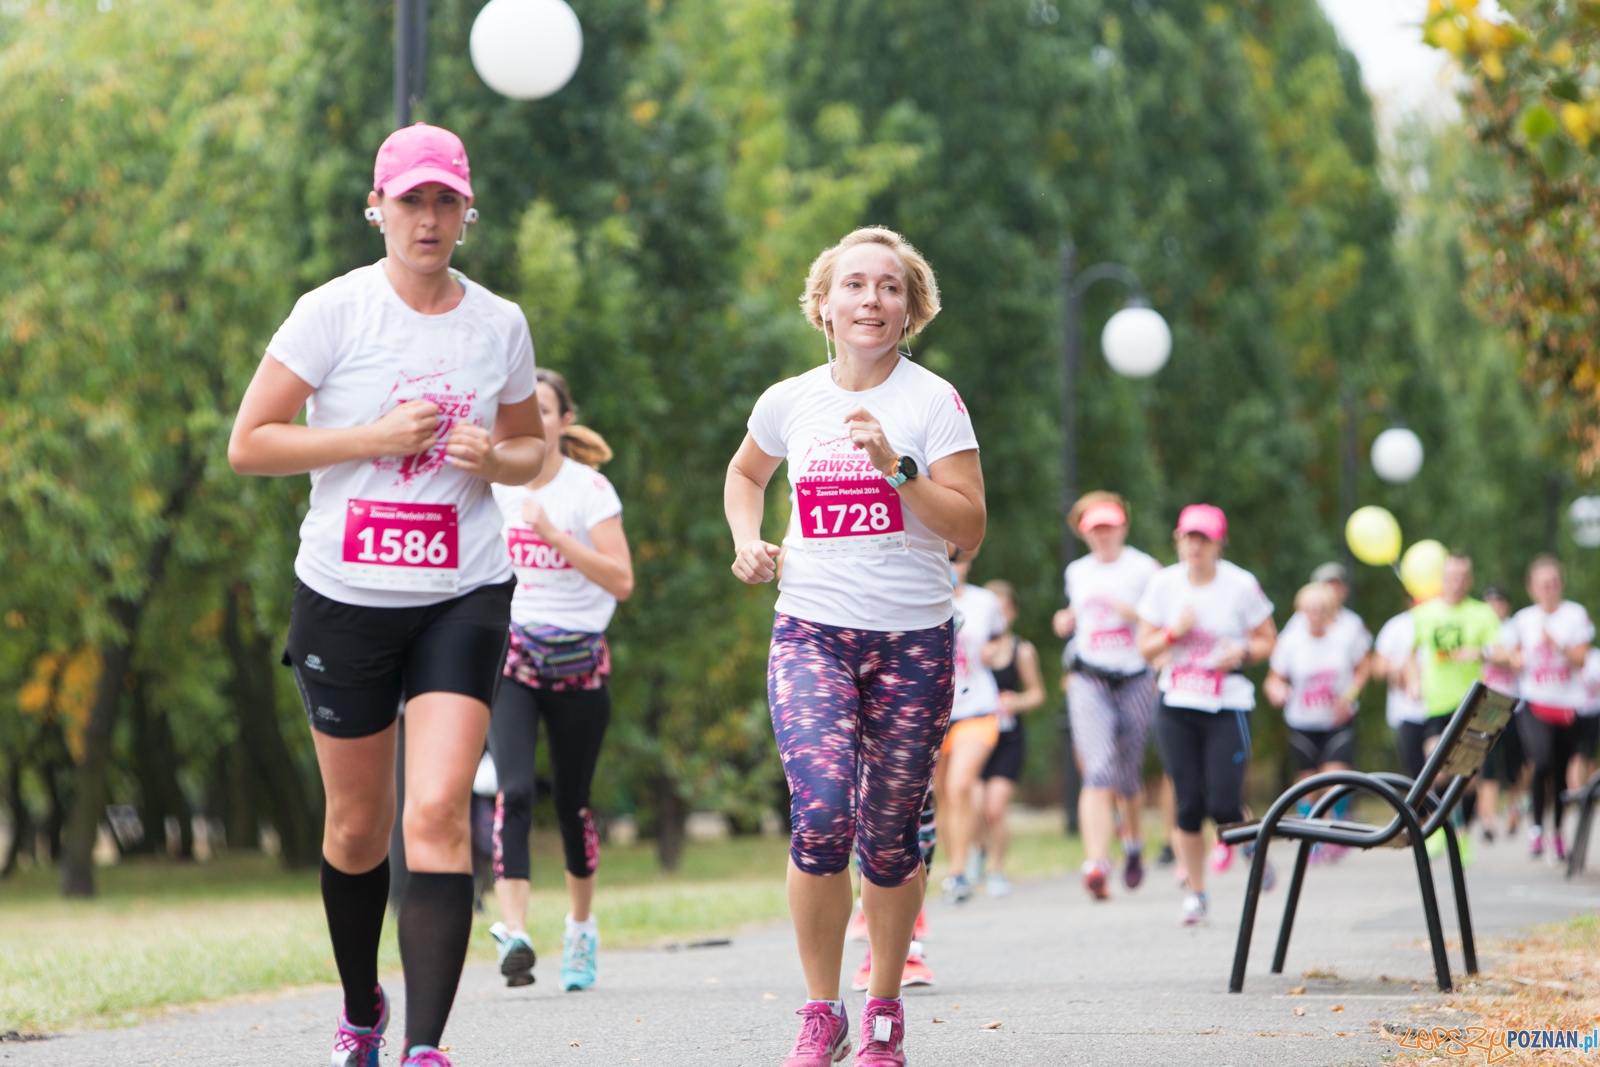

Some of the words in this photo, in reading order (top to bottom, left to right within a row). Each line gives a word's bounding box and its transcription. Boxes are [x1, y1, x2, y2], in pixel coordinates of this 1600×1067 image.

[807, 459, 875, 472] zawsze
[809, 502, 891, 535] 1728
[356, 526, 449, 565] 1586
[511, 542, 566, 569] 1700
